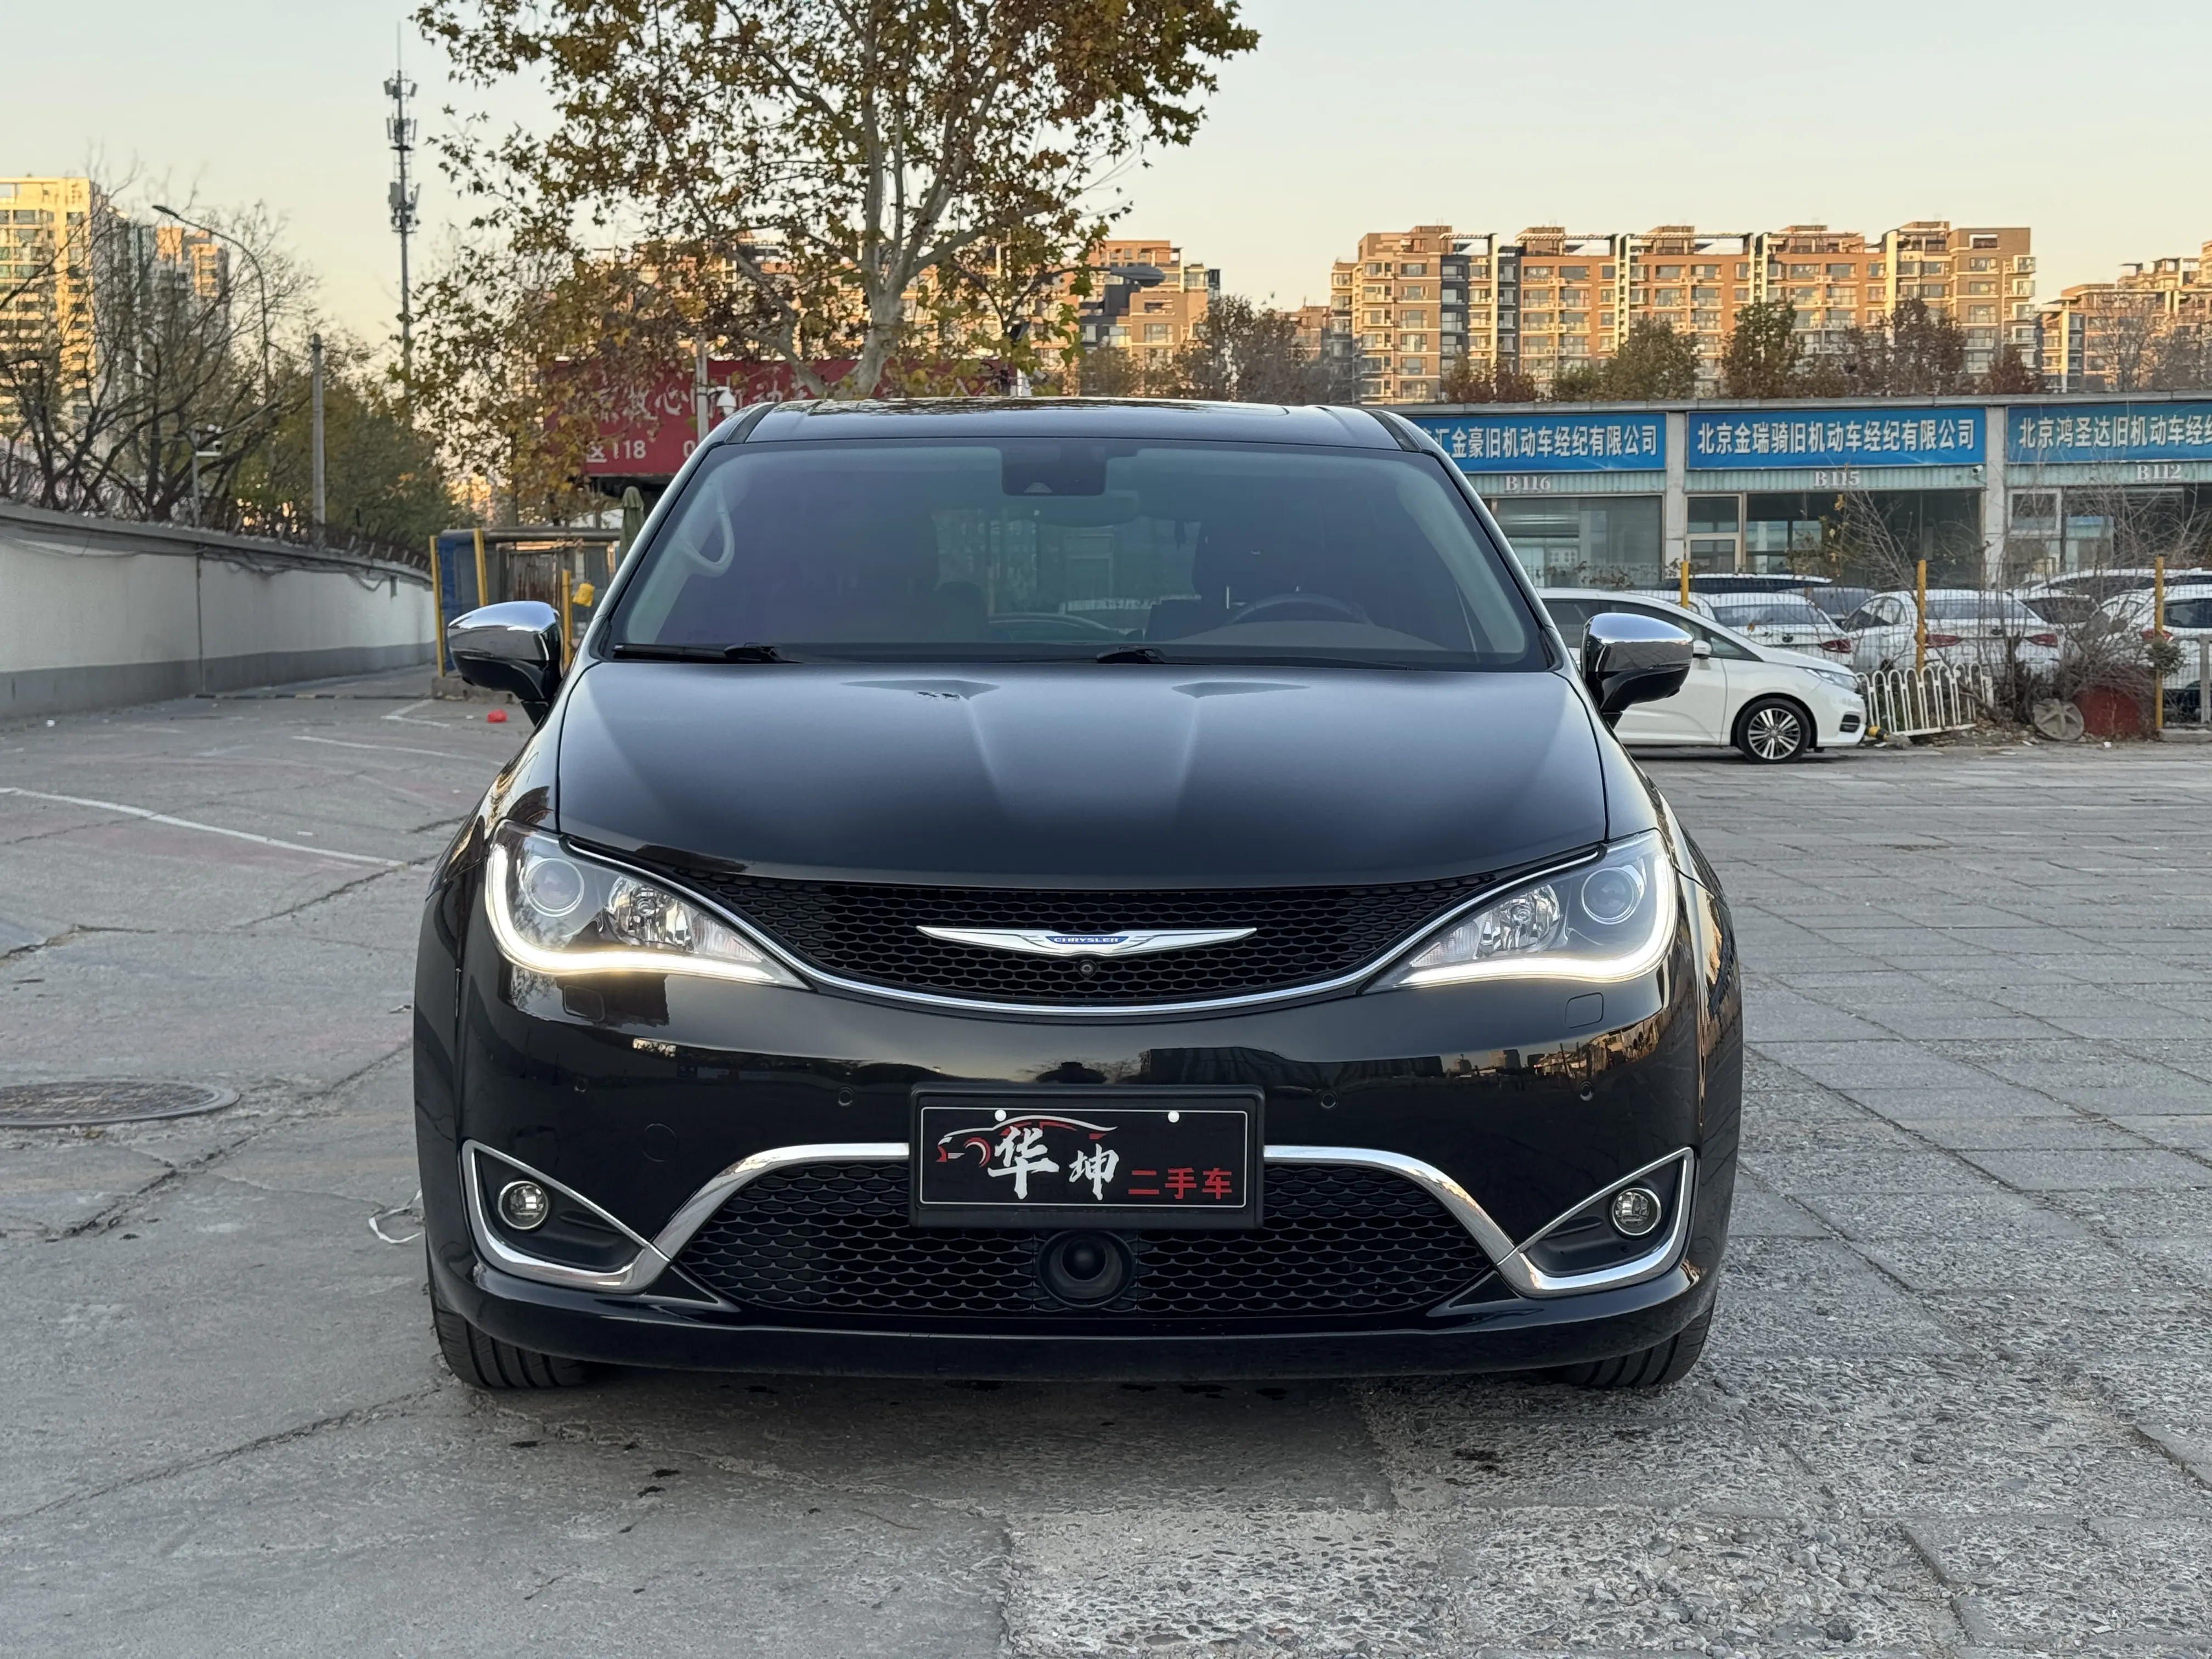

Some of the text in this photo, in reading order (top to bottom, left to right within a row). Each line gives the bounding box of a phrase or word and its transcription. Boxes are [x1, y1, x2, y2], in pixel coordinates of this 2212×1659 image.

[1423, 425, 1657, 458] 汇金豪旧机动车经纪有限公司
[1697, 419, 1974, 454] 北京金瑞骑旧机动车经纪有限公司
[1505, 475, 1551, 491] B116
[1814, 471, 1860, 487] B115
[2137, 464, 2182, 480] B112
[988, 1126, 1232, 1200] 华坤 二手车
